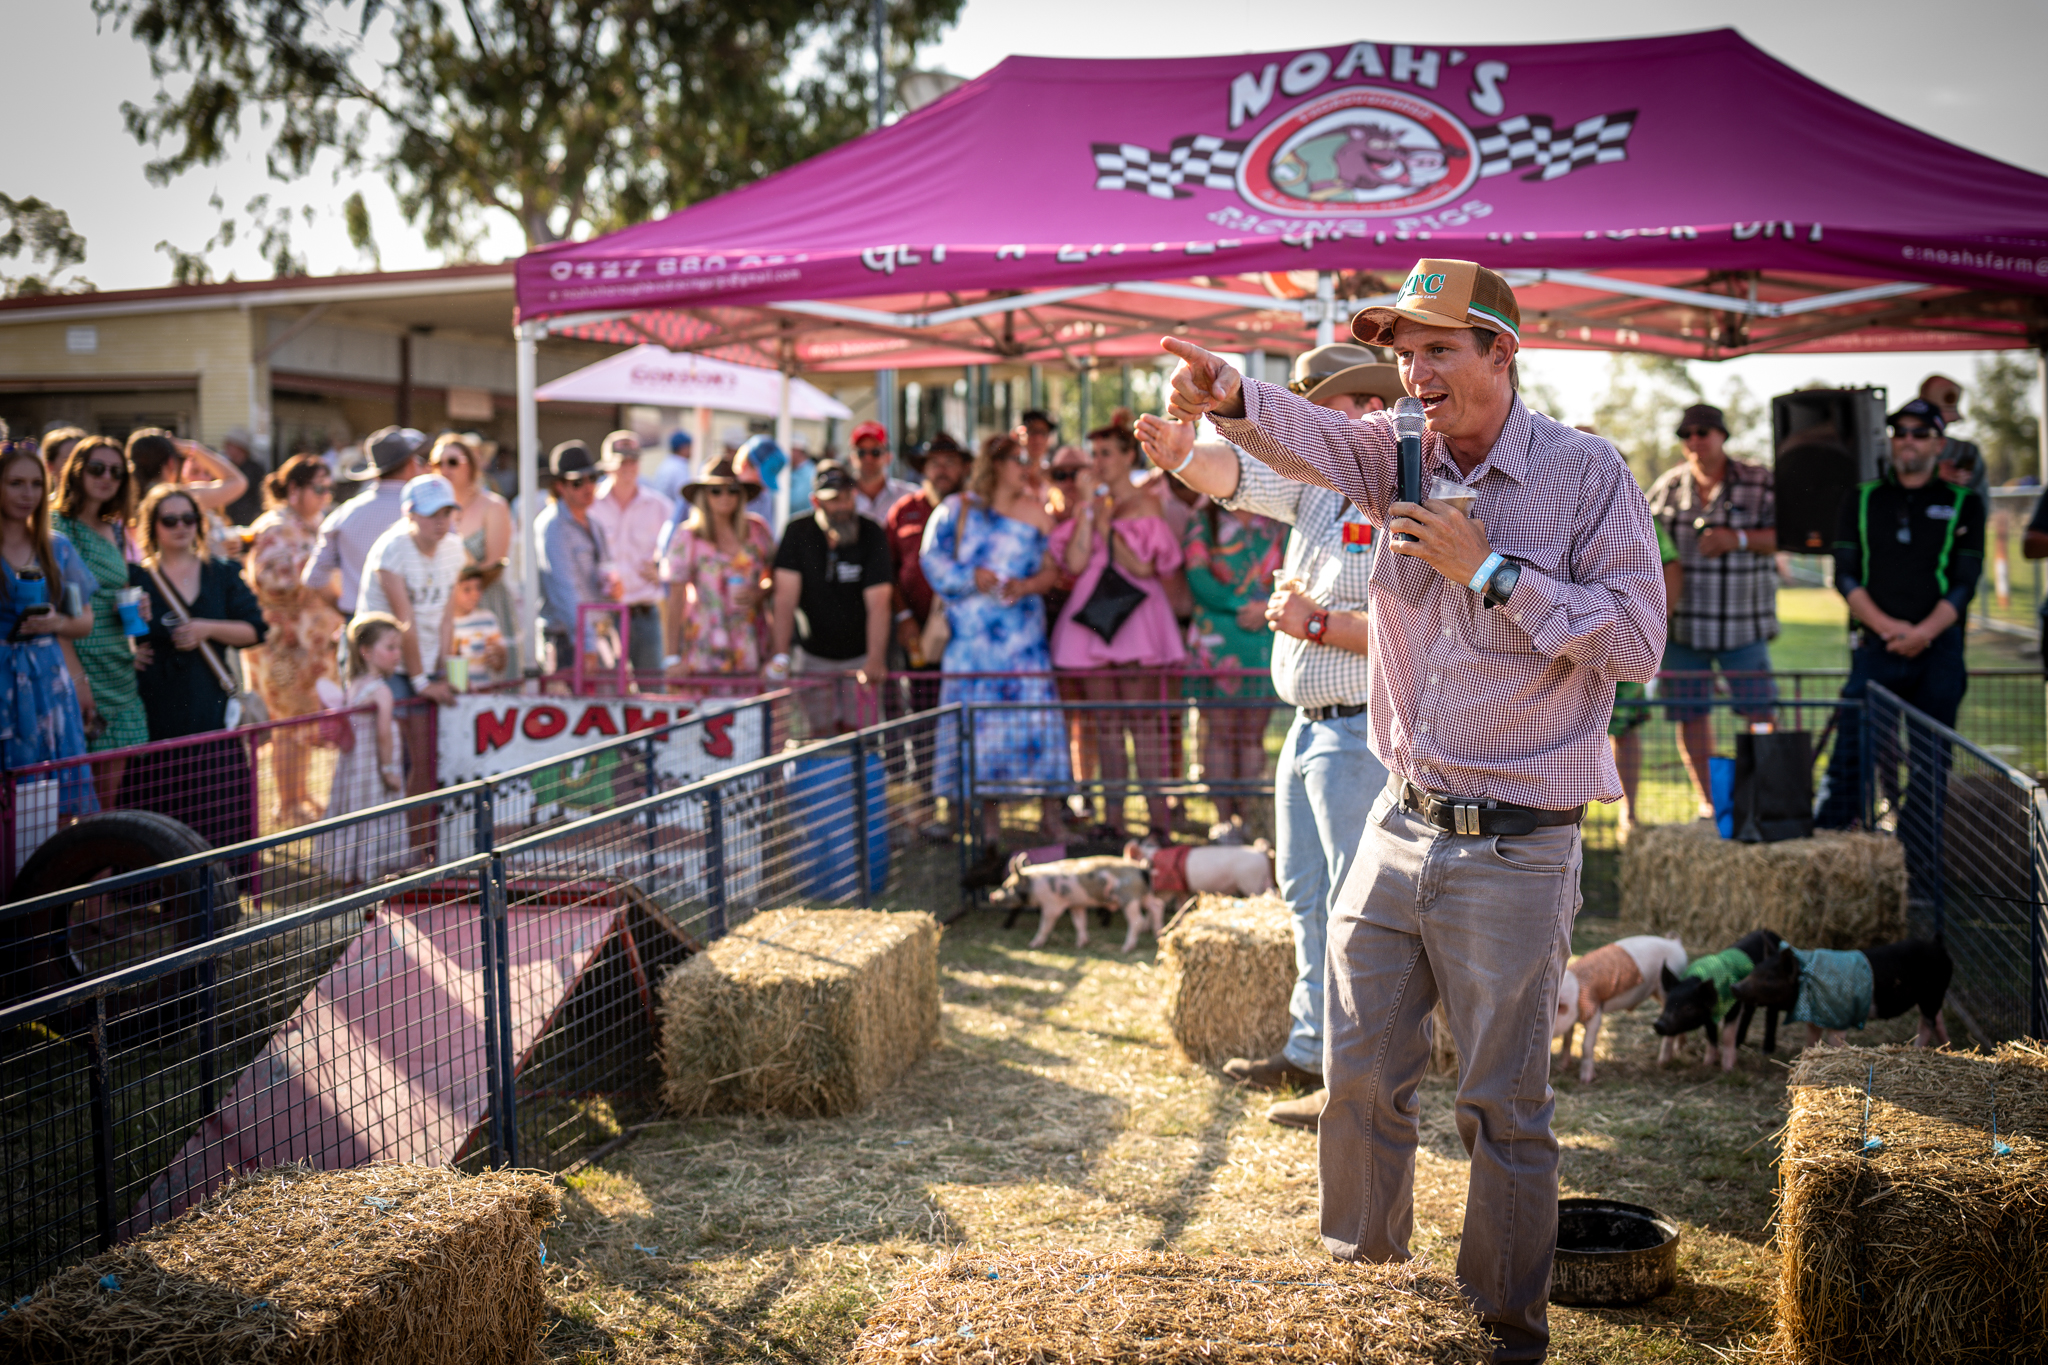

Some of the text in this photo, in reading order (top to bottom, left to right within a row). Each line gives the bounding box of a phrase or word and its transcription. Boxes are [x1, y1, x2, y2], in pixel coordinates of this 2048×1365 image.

[1228, 41, 1509, 130] NOAH'S
[1206, 199, 1494, 238] RACING PIGS
[1472, 557, 1498, 588] 18+ 18+
[475, 704, 735, 759] NOAH'S
